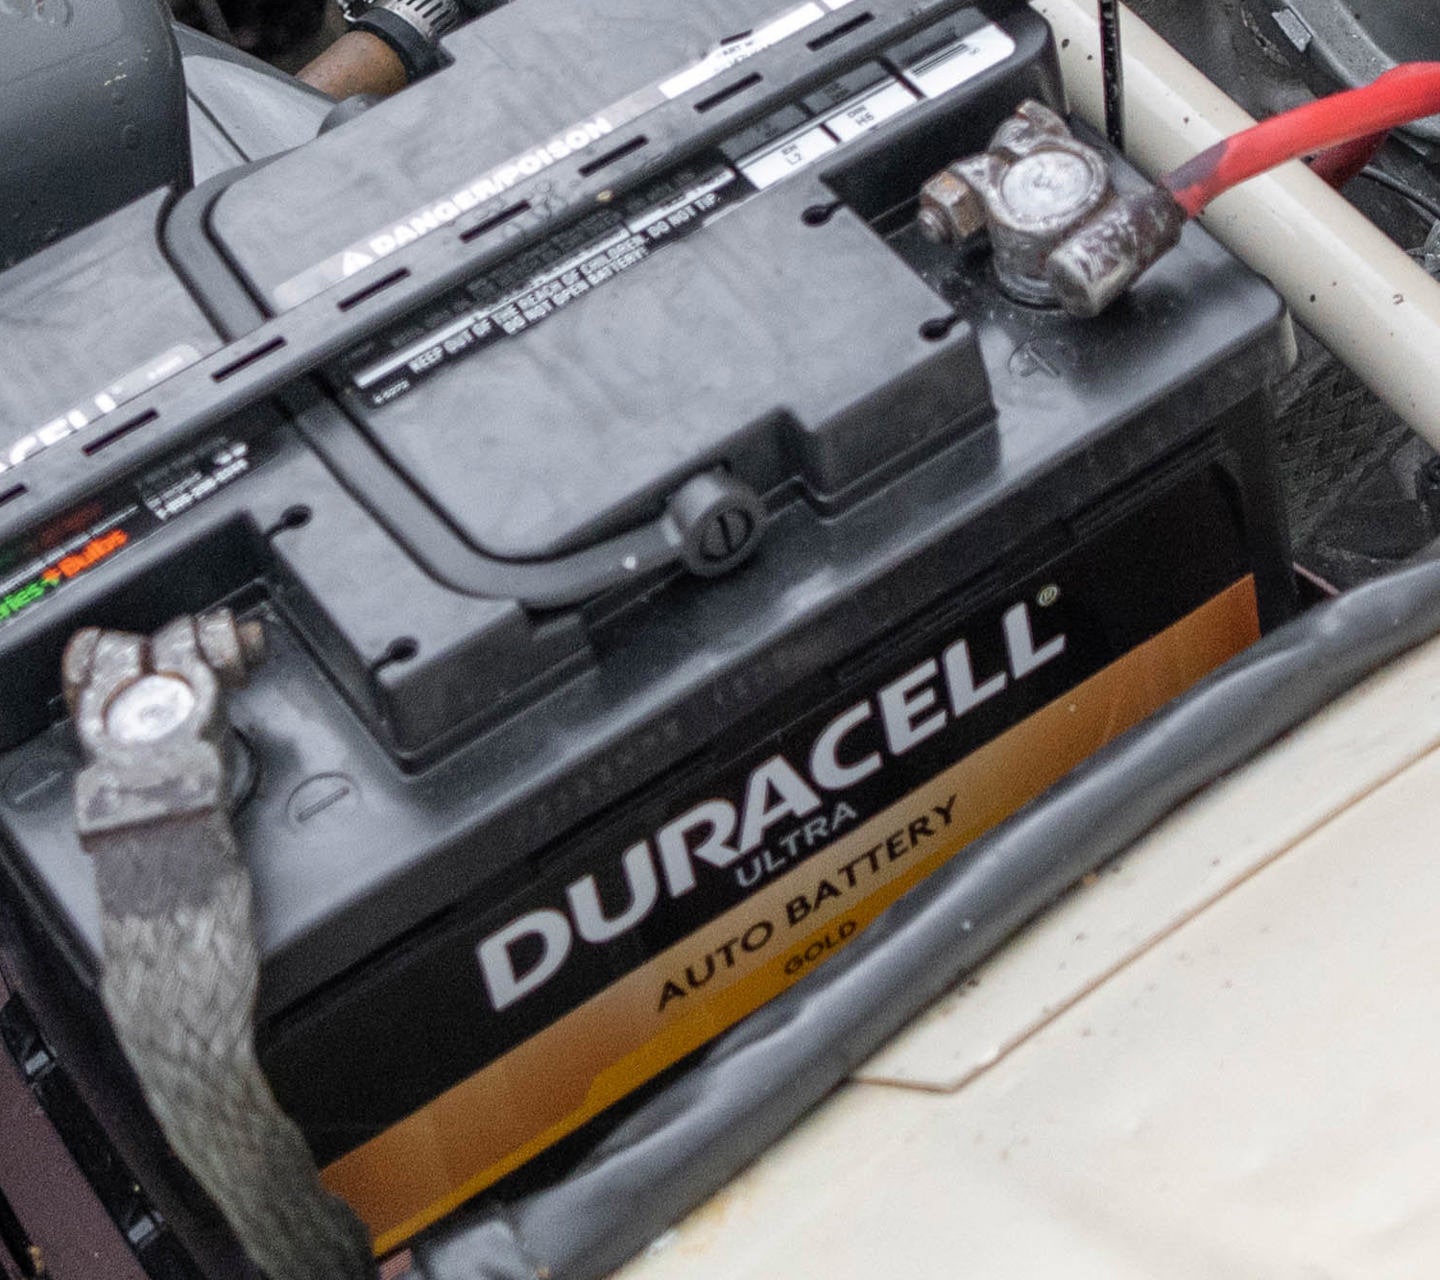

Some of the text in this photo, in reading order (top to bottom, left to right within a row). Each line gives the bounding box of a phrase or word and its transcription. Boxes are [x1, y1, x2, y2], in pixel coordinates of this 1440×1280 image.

[371, 117, 615, 257] DANGER/POISON
[408, 344, 445, 375] KEEP
[443, 327, 477, 355] OUT
[472, 316, 494, 341] OF
[517, 281, 565, 316] REACH
[563, 267, 584, 294] OF
[647, 216, 672, 241] DO
[669, 204, 699, 232] NOT
[500, 309, 527, 336] DO
[524, 297, 555, 329] NOT
[553, 280, 591, 314] OPEN
[734, 801, 859, 888] ULTRA
[655, 793, 961, 1013] AUTO BATTERY
[782, 917, 860, 977] GOLD
